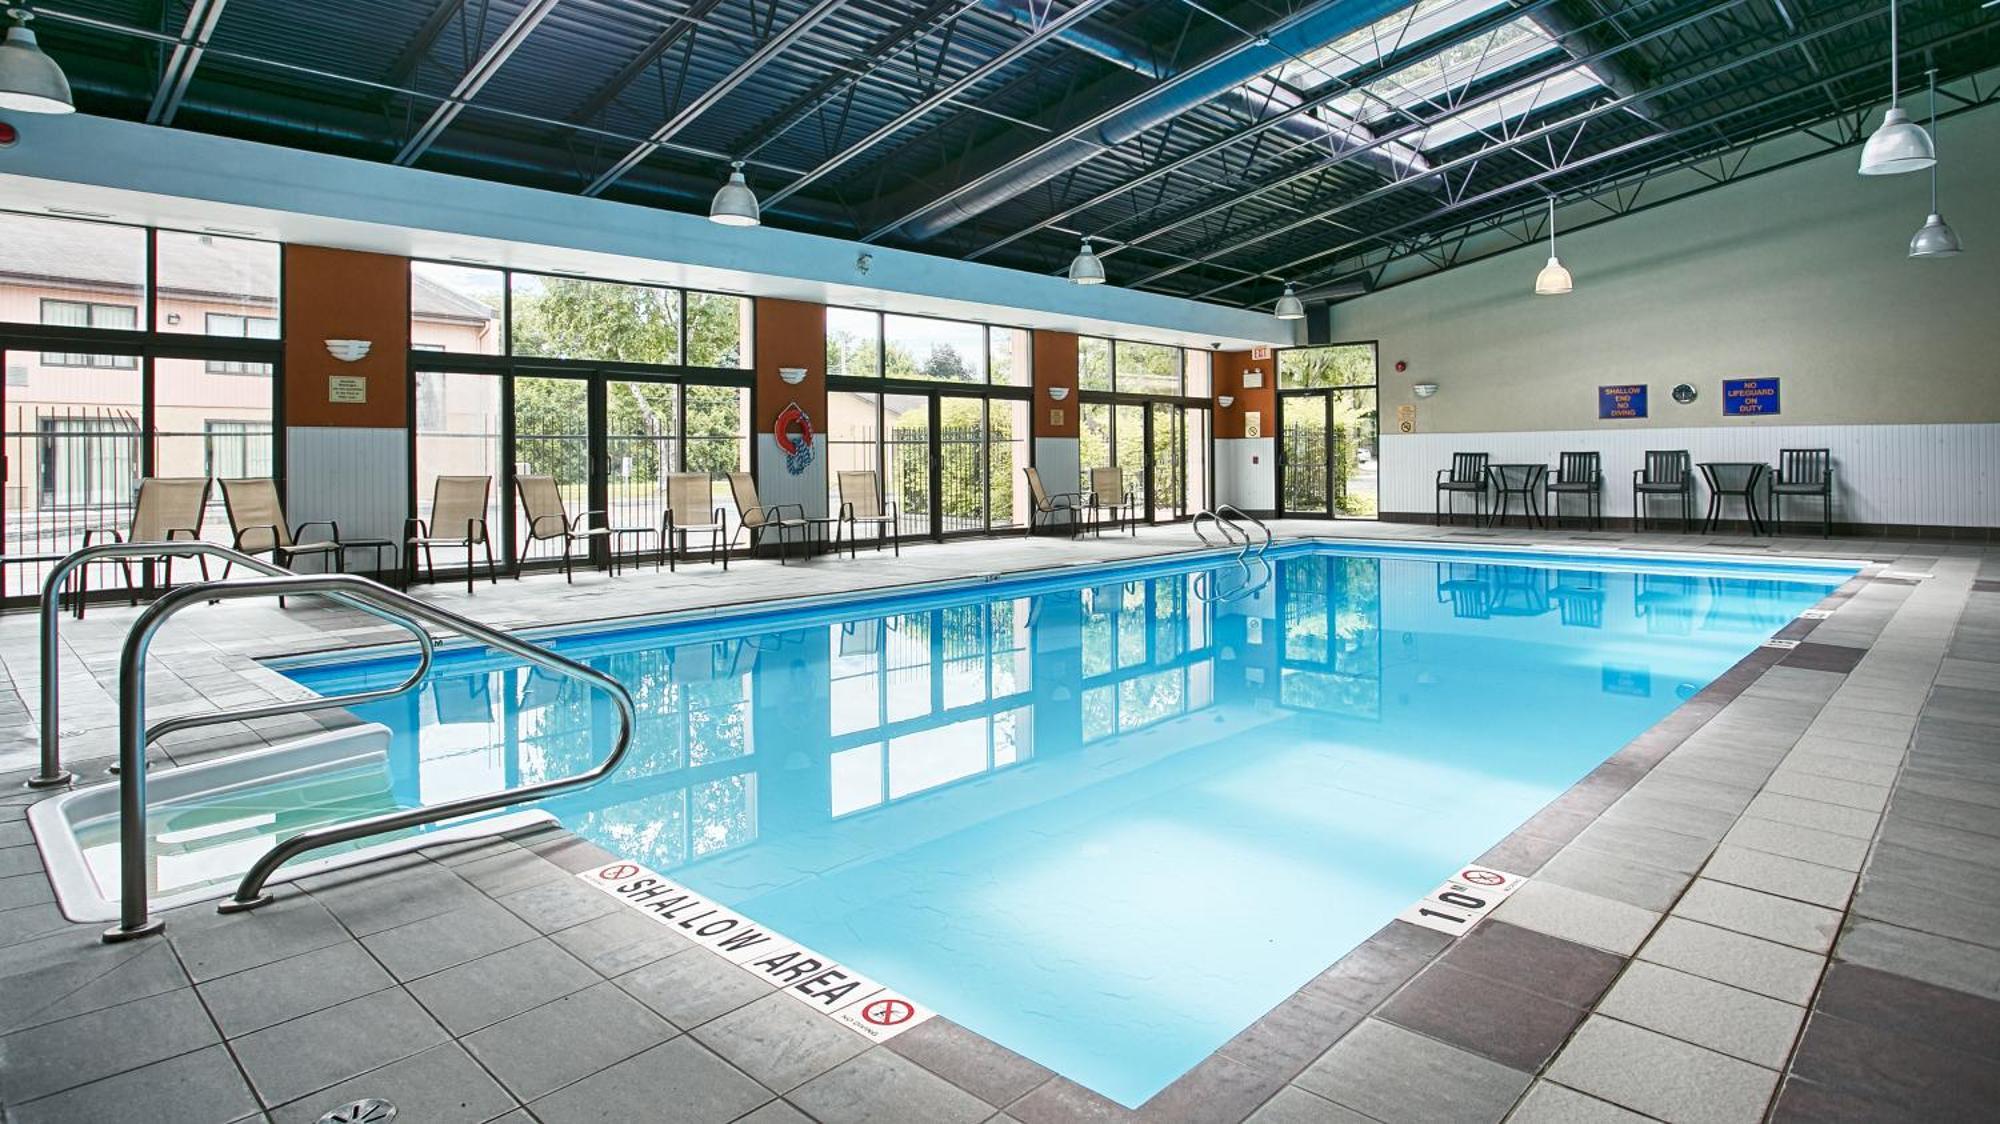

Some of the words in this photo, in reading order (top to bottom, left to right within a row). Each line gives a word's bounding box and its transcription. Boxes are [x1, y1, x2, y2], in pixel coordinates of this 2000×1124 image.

[1604, 387, 1640, 395] SHALLOW
[1728, 389, 1775, 397] LIFEGUARD
[1739, 404, 1762, 412] DUTY
[1610, 409, 1636, 417] DIVING
[617, 878, 772, 952] SHALLOW
[753, 951, 861, 1005] AREA
